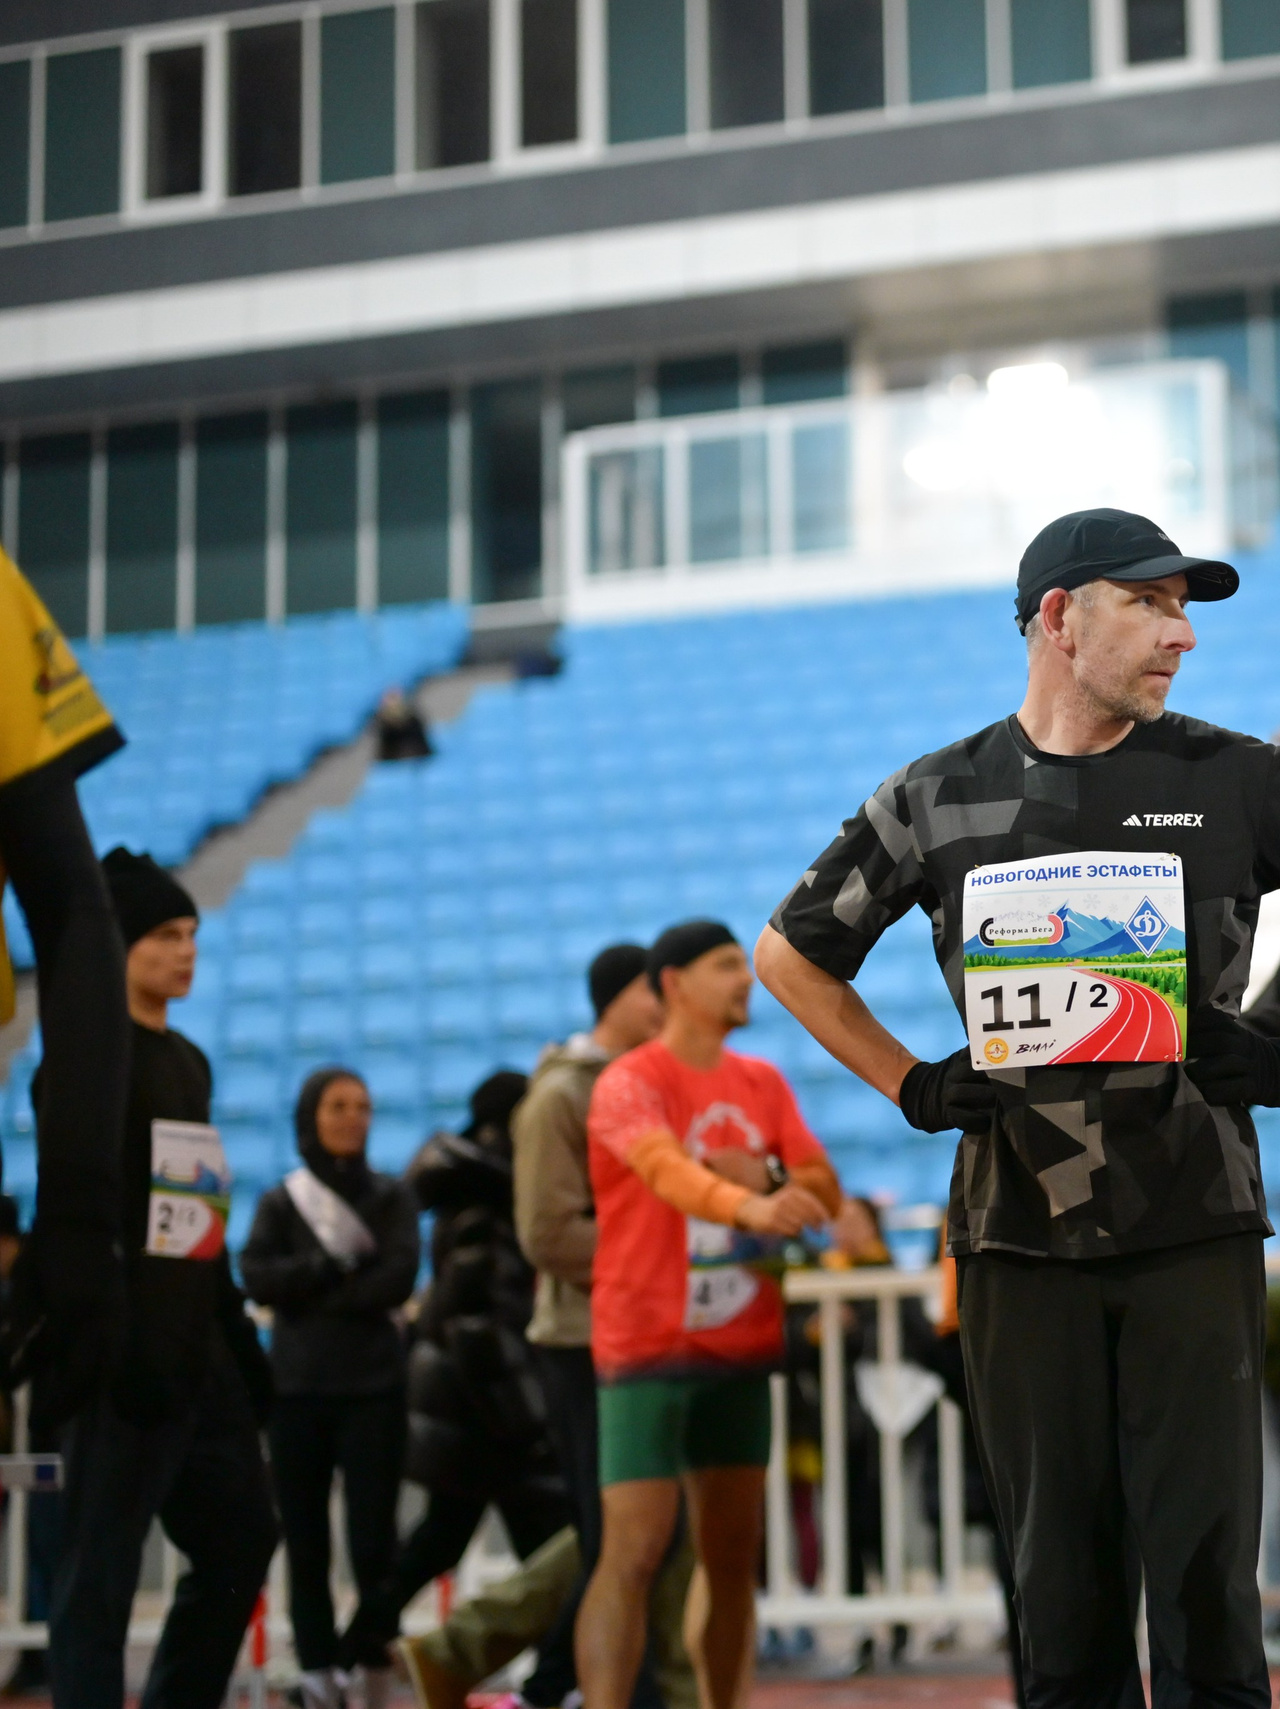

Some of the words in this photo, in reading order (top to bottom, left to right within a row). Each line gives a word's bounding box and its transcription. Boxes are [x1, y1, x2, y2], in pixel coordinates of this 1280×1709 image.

[1143, 813, 1204, 827] TERREX
[971, 865, 1082, 887] НОВОГОДНИЕ
[1087, 864, 1177, 878] ЭСТАФЕТЫ
[989, 927, 1029, 936] Реформа
[981, 983, 1051, 1032] 11
